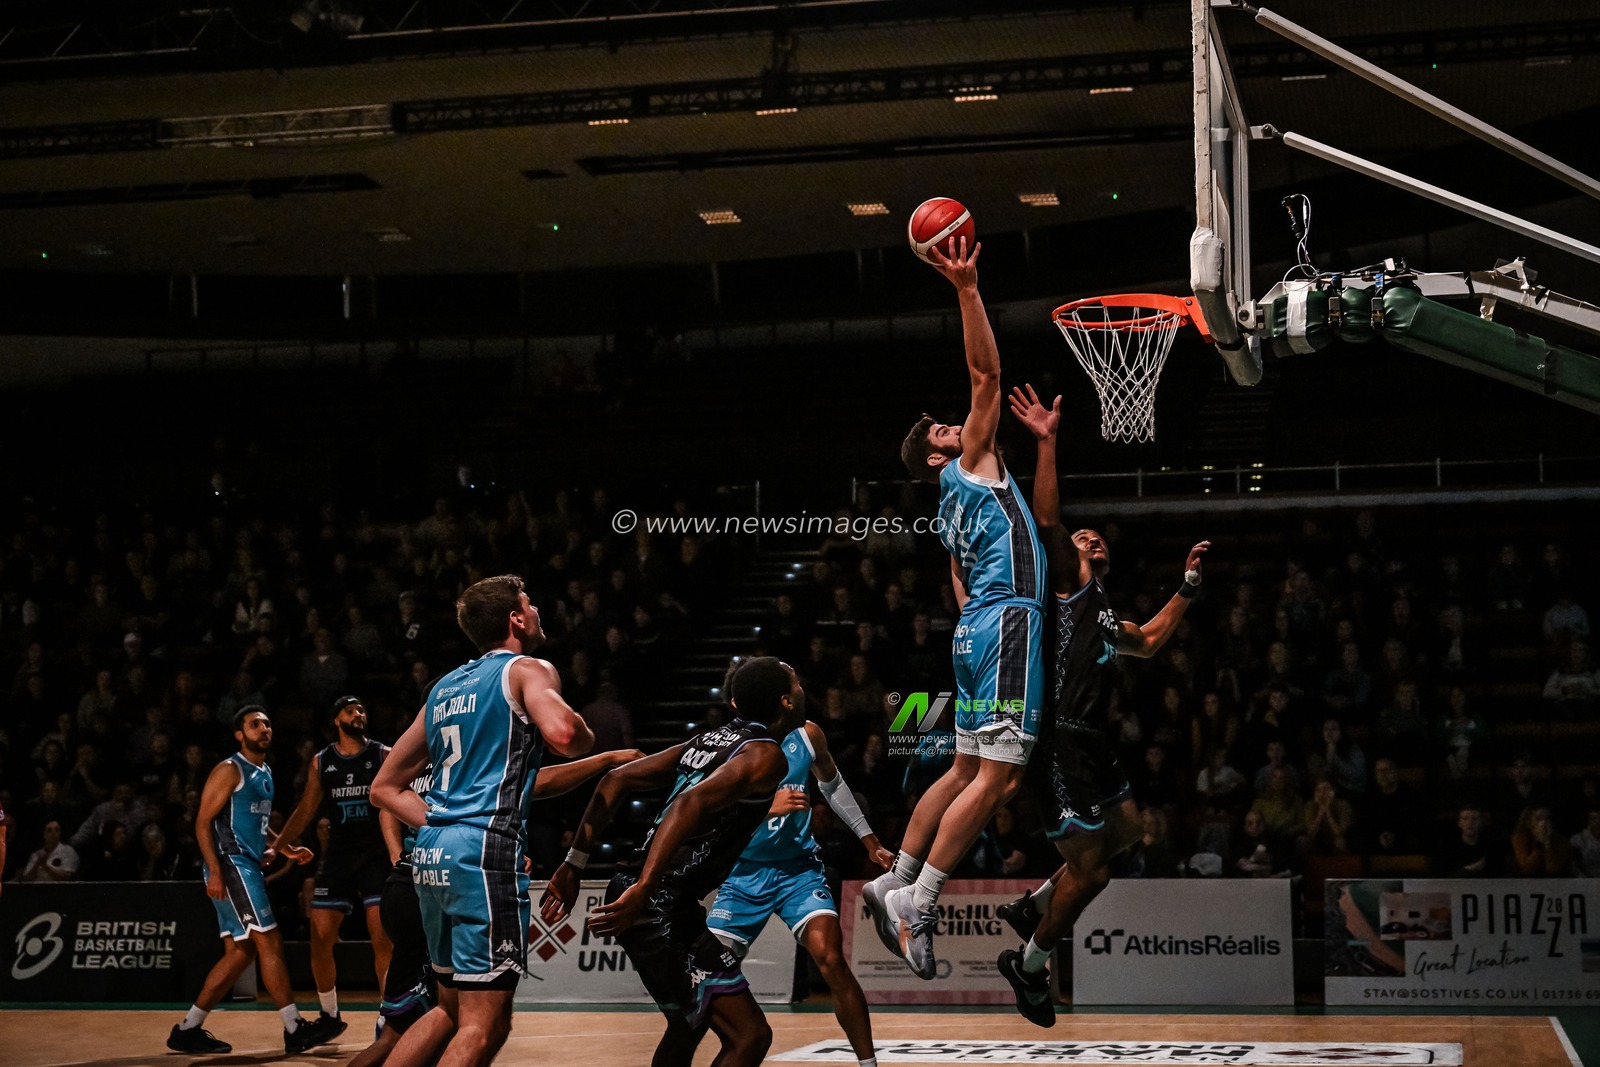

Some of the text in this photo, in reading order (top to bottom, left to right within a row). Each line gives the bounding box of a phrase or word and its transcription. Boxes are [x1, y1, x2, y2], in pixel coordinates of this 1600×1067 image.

[440, 724, 462, 792] 7
[346, 773, 354, 785] 3
[422, 869, 451, 886] ABLE
[1547, 898, 1562, 912] 28
[76, 921, 177, 936] BRITISH
[74, 939, 173, 952] BASKETBALL
[1124, 933, 1280, 955] AtkinsRéalis
[71, 954, 172, 969] LEAGUE
[1413, 940, 1529, 981] Great Location
[1363, 988, 1529, 999] STAY@SOSTIVES.CO.UK
[1542, 989, 1582, 999] 01736
